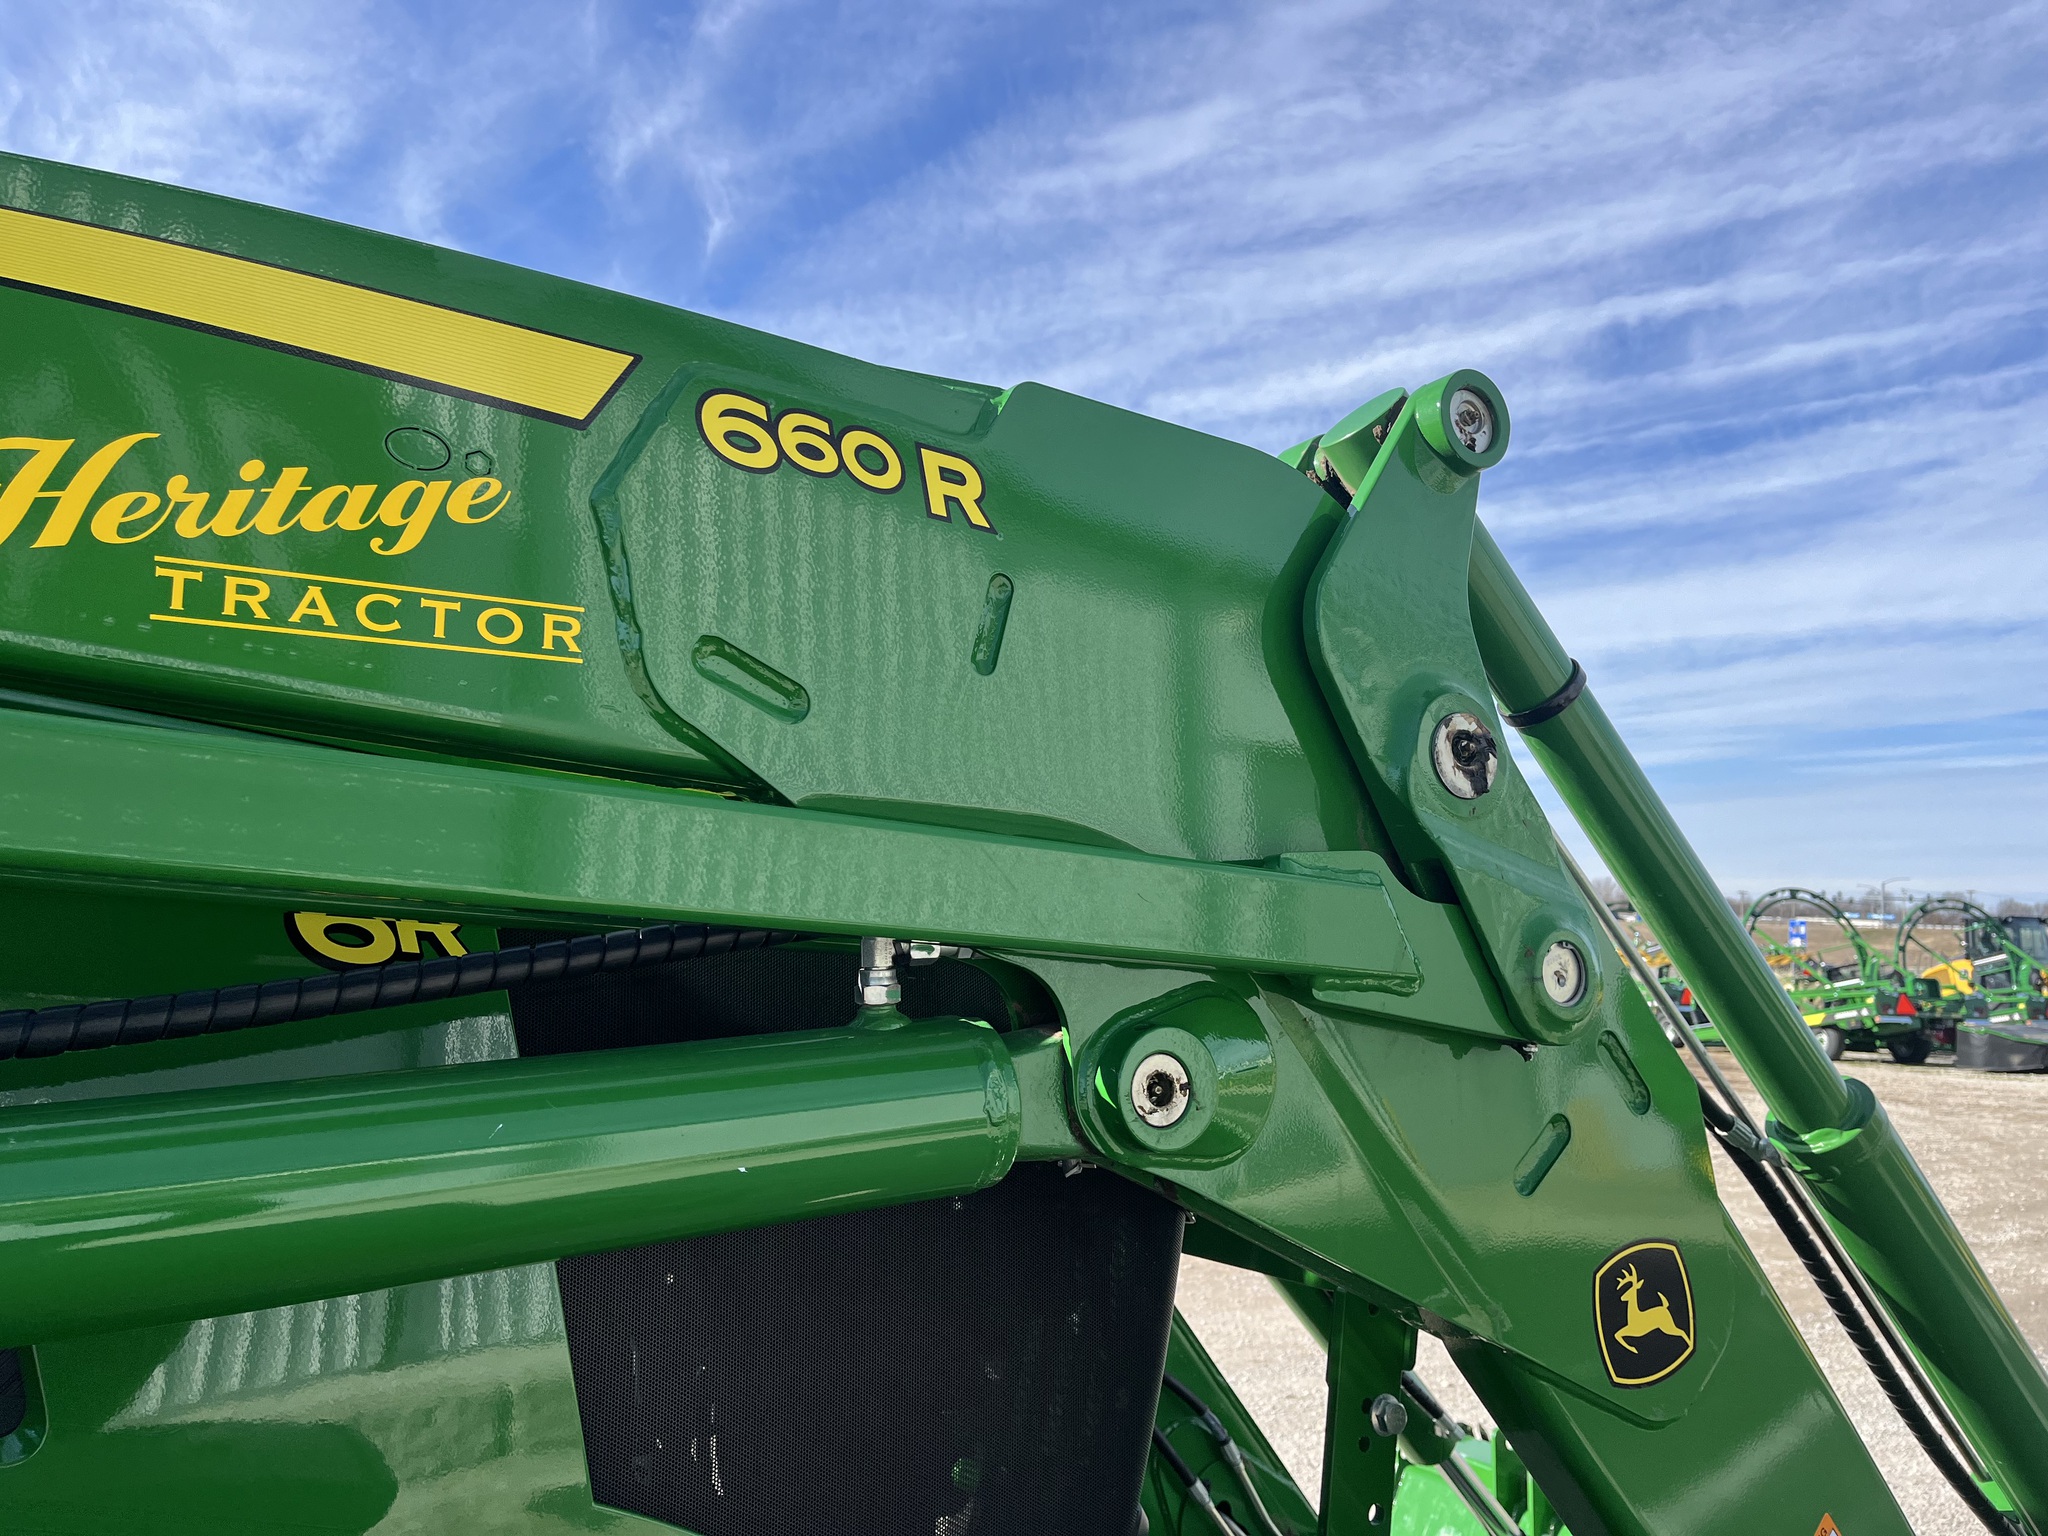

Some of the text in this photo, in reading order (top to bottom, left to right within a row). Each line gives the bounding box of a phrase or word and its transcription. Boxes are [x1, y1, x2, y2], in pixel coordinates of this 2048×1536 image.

[0, 432, 511, 556] Heritage
[697, 390, 994, 532] 660 R
[155, 566, 582, 653] TRACTOR
